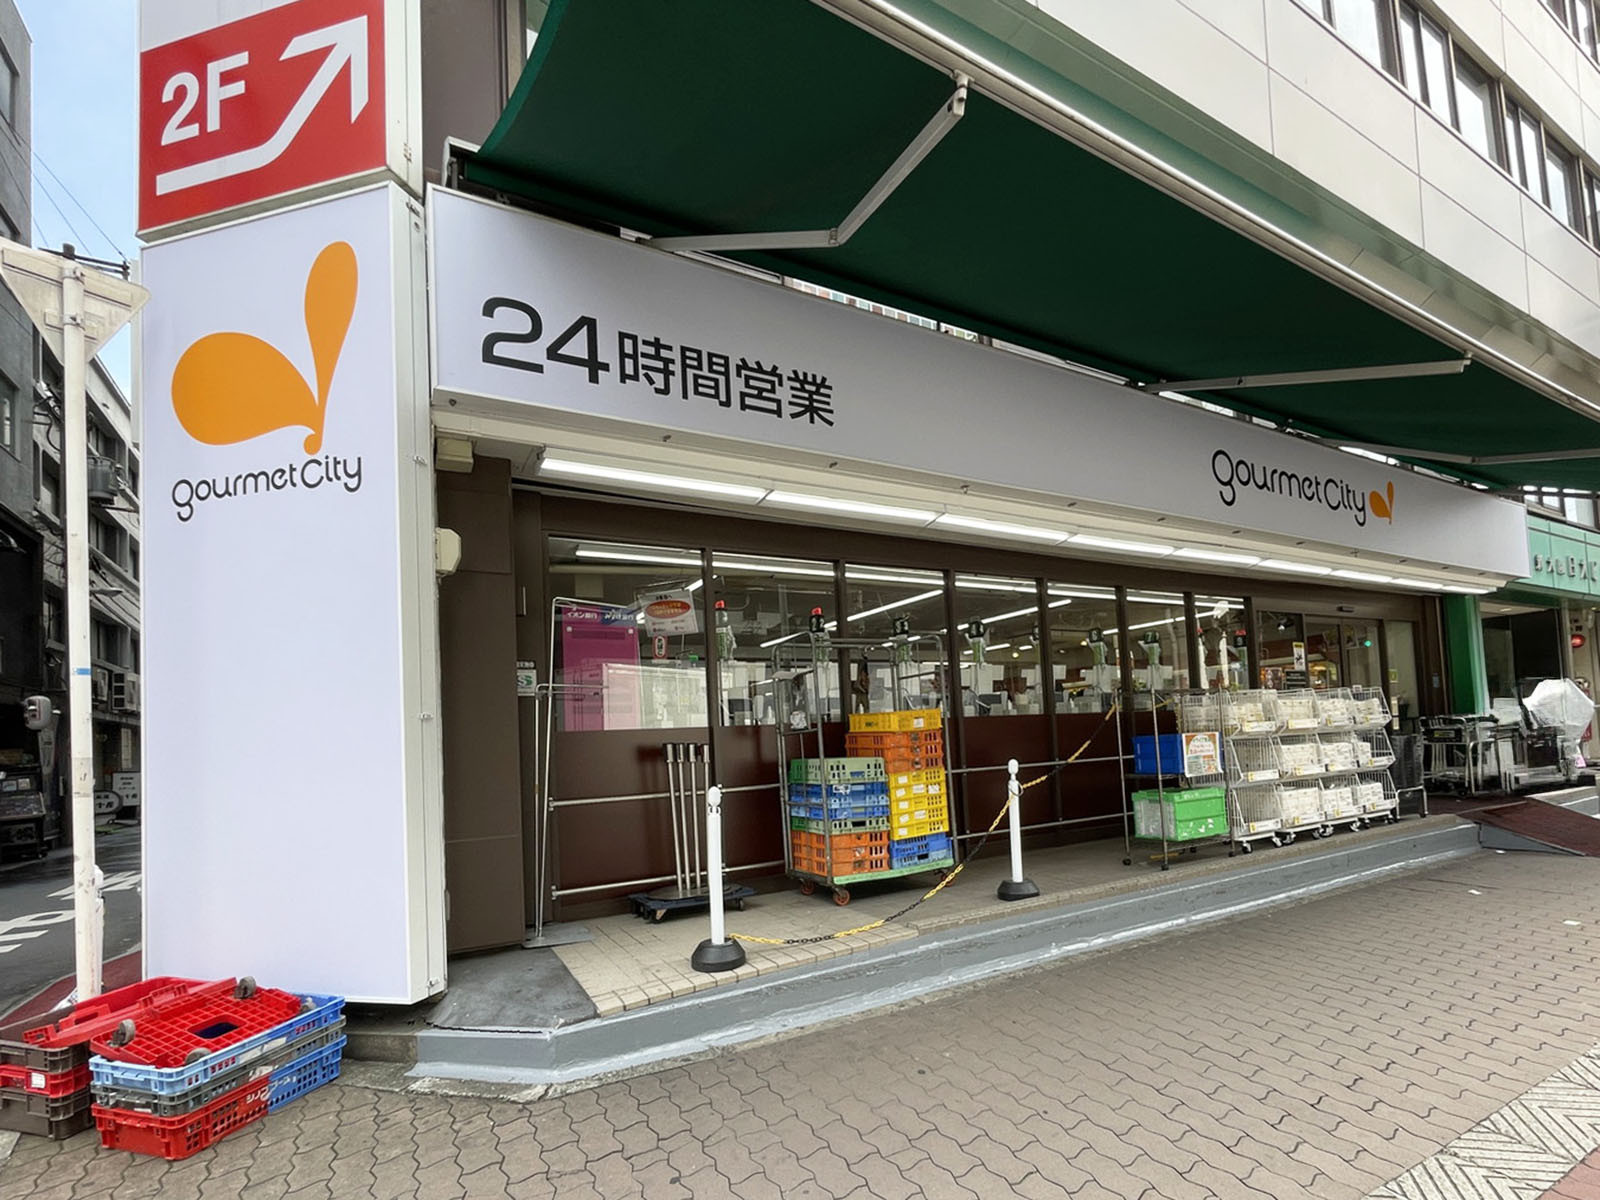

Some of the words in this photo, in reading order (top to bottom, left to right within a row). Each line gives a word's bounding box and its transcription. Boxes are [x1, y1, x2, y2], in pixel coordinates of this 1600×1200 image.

[161, 51, 250, 147] 2F
[481, 296, 835, 428] 24時間営業
[171, 455, 363, 522] gourmetCity
[1211, 449, 1367, 528] gourmetCity
